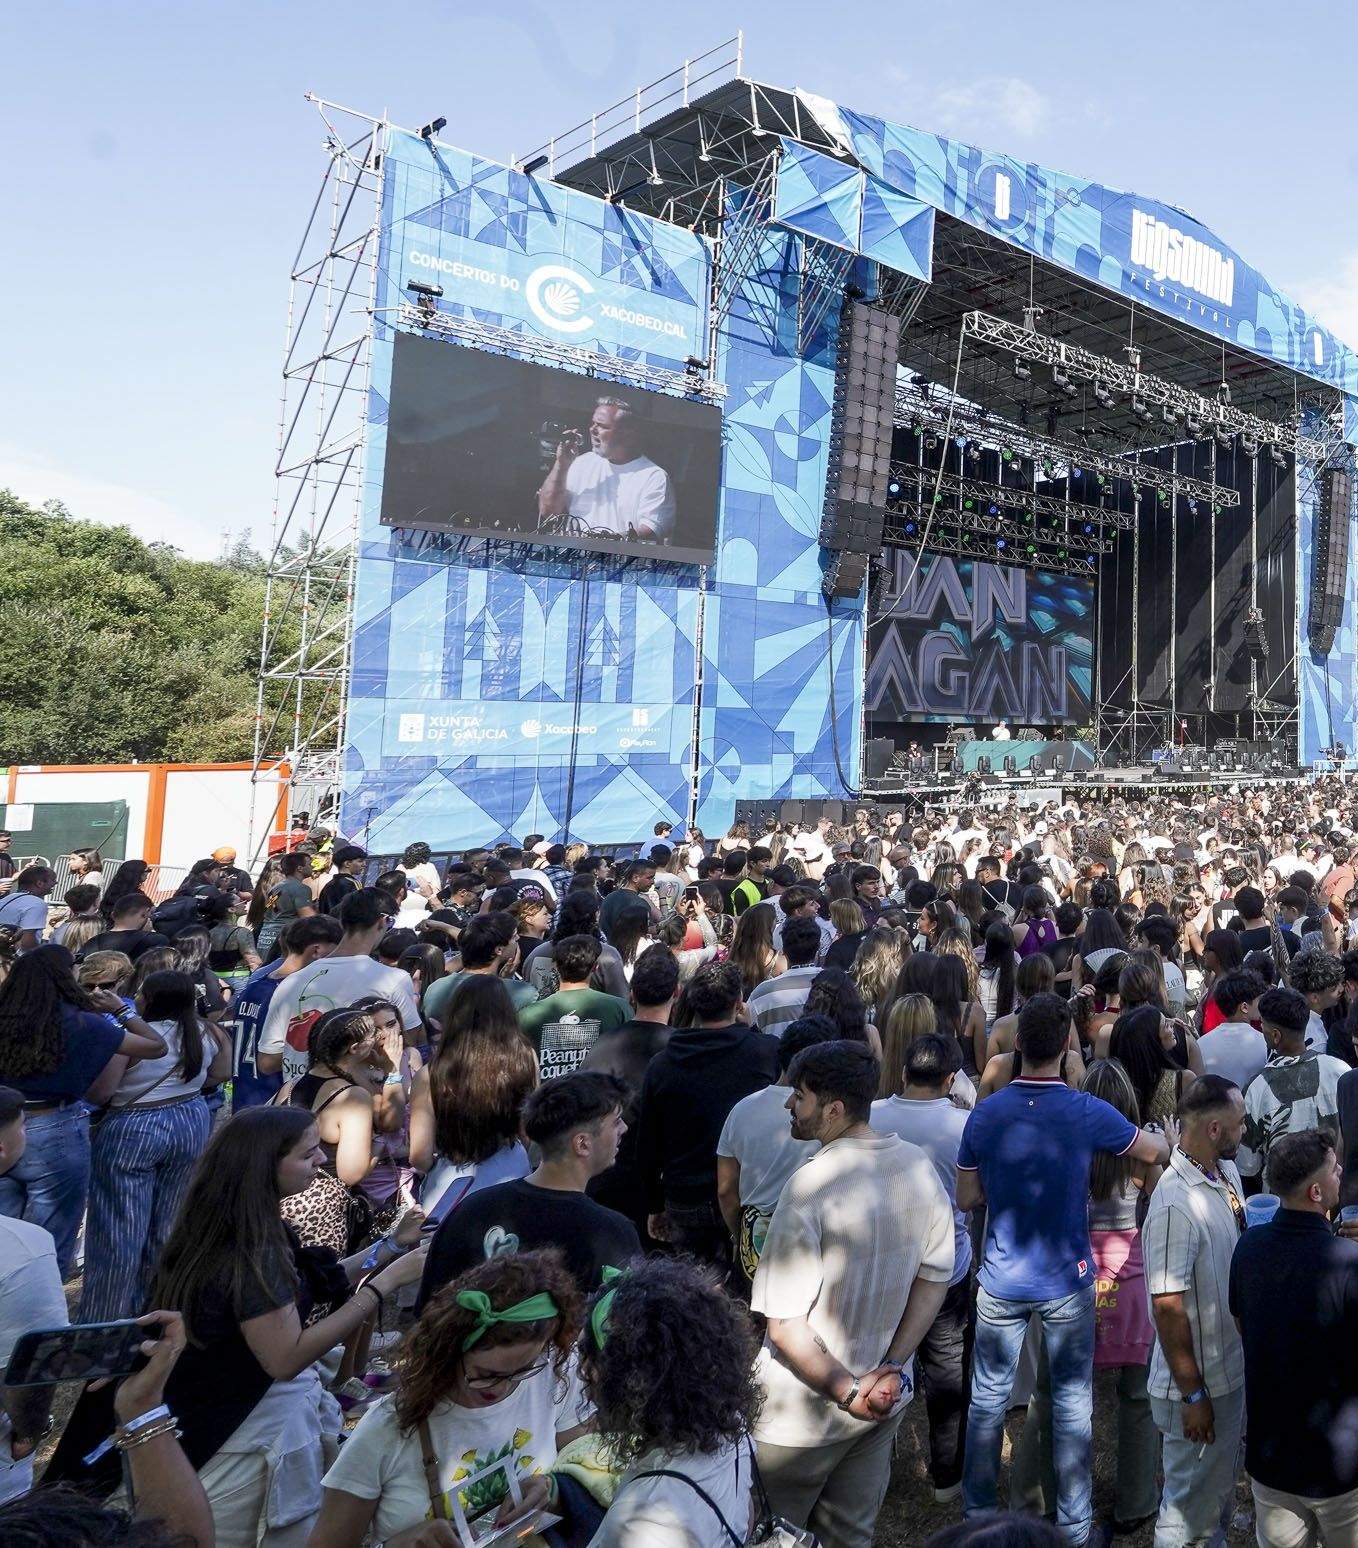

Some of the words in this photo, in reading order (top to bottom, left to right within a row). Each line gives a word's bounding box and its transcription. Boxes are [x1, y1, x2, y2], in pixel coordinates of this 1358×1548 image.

[409, 250, 497, 285] CONCERTOS
[500, 274, 520, 291] DO
[1130, 272, 1231, 328] FESTIVAL
[863, 619, 1069, 723] AGAN
[427, 728, 448, 739] DE
[451, 728, 509, 740] GALICIA
[429, 715, 481, 728] XUNTA
[544, 723, 598, 735] Xacobeo
[233, 1019, 258, 1080] 14
